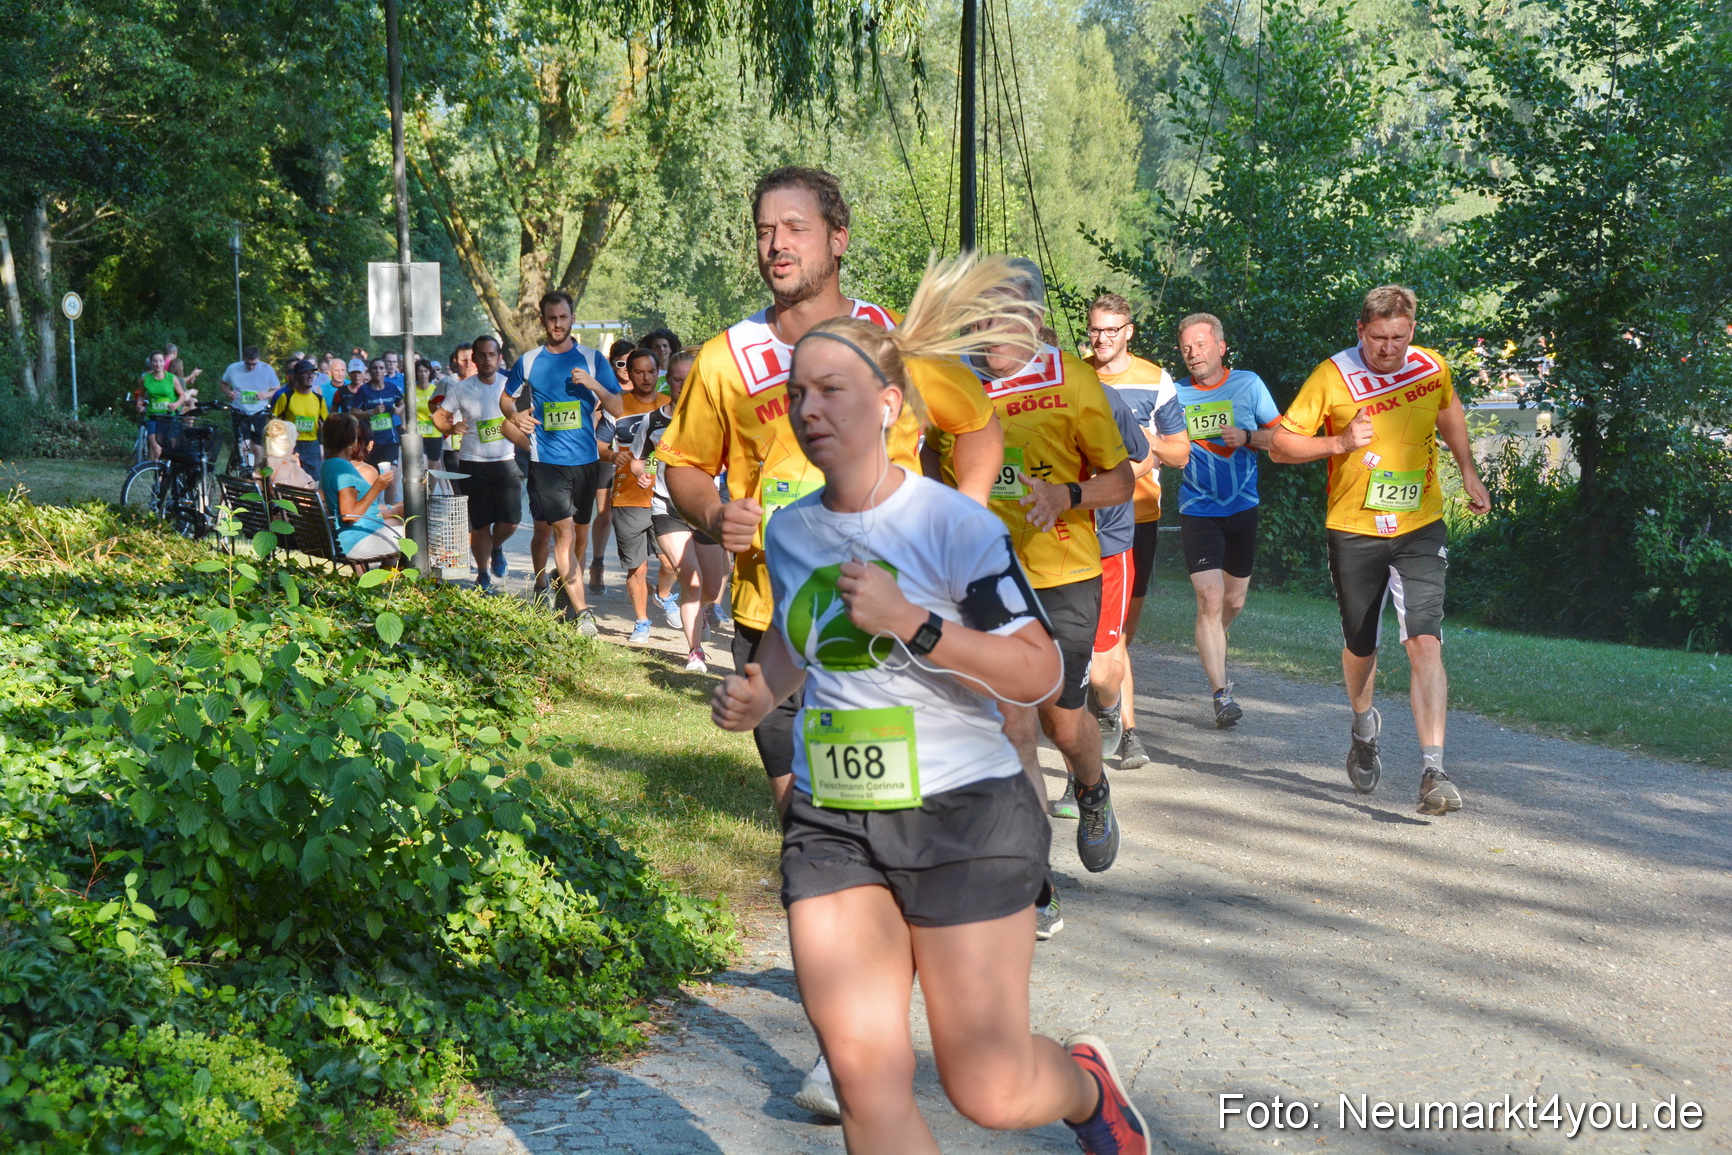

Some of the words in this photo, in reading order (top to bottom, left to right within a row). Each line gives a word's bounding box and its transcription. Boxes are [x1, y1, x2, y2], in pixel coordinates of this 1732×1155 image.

[1404, 379, 1442, 403] BÖGL
[1006, 395, 1068, 417] BÖGL
[548, 411, 577, 423] 1174
[1192, 413, 1228, 429] 1578
[1377, 484, 1418, 500] 1219
[826, 745, 885, 779] 168
[819, 780, 864, 791] Fleischmann
[866, 781, 905, 791] Corinna
